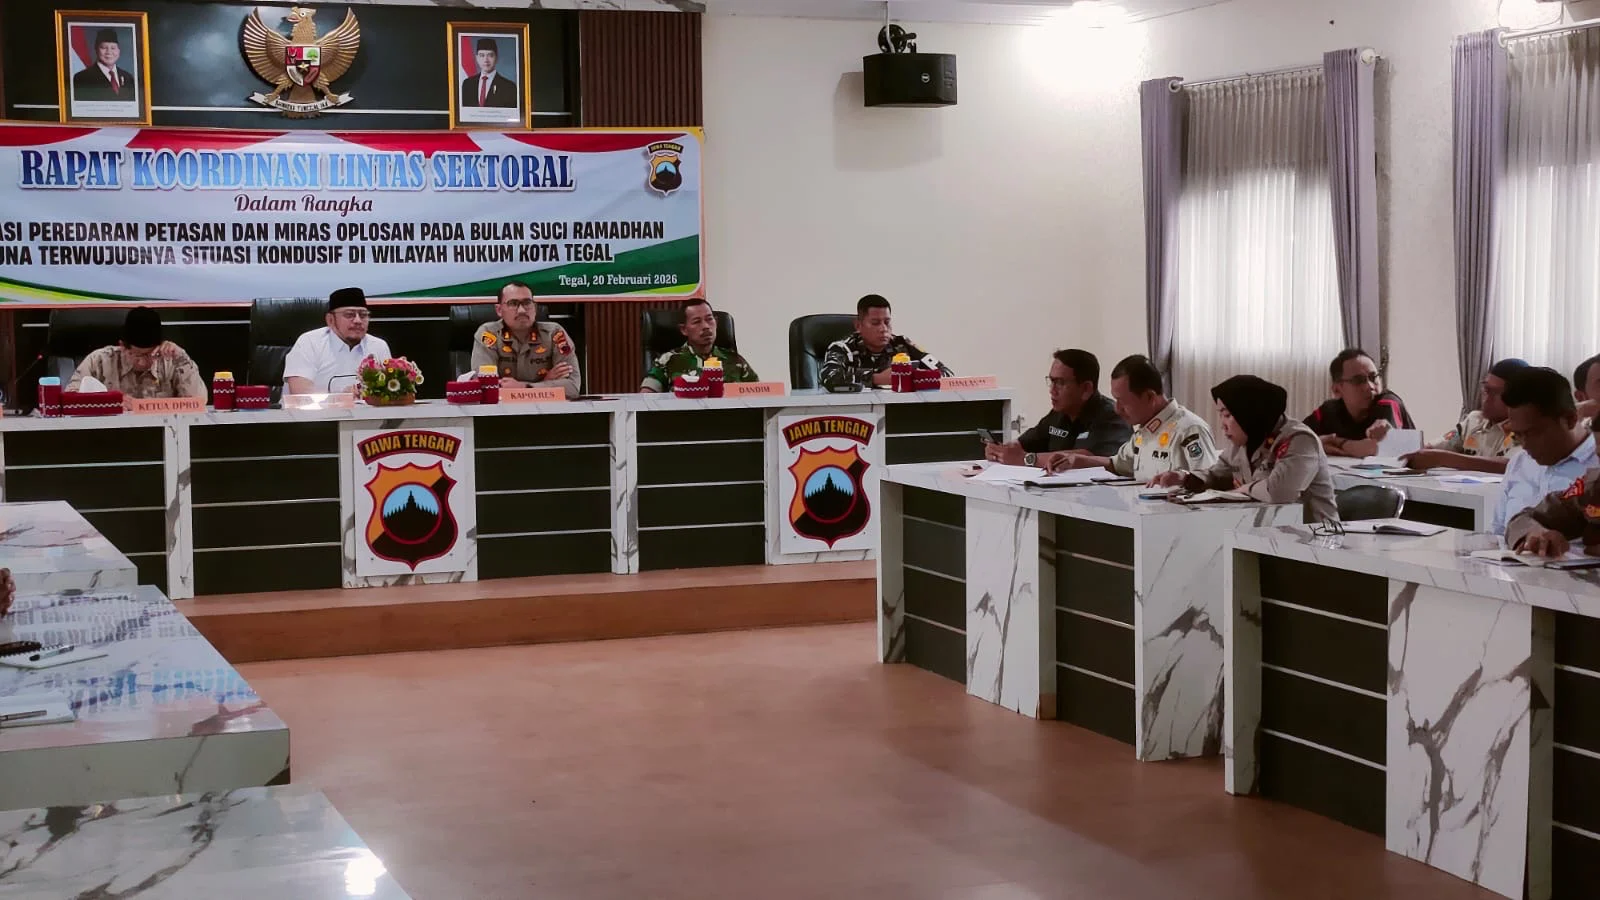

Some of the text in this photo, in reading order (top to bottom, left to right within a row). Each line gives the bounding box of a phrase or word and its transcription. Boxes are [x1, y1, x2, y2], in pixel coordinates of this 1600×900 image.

[20, 149, 574, 188] RAPAT KOORDINASI LINTAS SEKTORAL
[234, 193, 373, 217] Dalam Rangka
[29, 222, 139, 242] PEREDARAN
[145, 222, 226, 242] PETASAN
[232, 222, 269, 242] DAN
[275, 222, 331, 242] MIRAS
[336, 222, 415, 242] OPLOSAN
[420, 222, 465, 241] PADA
[470, 222, 525, 241] BULAN
[530, 221, 568, 240] SUCI
[573, 221, 664, 239] RAMADHAN
[38, 245, 176, 265] TERWUJUDNYA
[182, 245, 251, 265] SITUASI
[257, 245, 343, 264] KONDUSIF
[350, 245, 366, 264] DI
[371, 245, 448, 263] WILAYAH
[453, 244, 514, 262] HUKUM
[519, 244, 560, 262] KOTA
[564, 243, 614, 262] TEGAL
[558, 274, 678, 288] Tegal, 20 Februari 2026
[511, 391, 555, 400] KAPOLRES
[738, 386, 770, 394] DANDIM
[138, 400, 200, 411] KETUA DPRD
[788, 420, 868, 441] JAWA TENGAH
[364, 434, 455, 457] JAWA TENGAH
